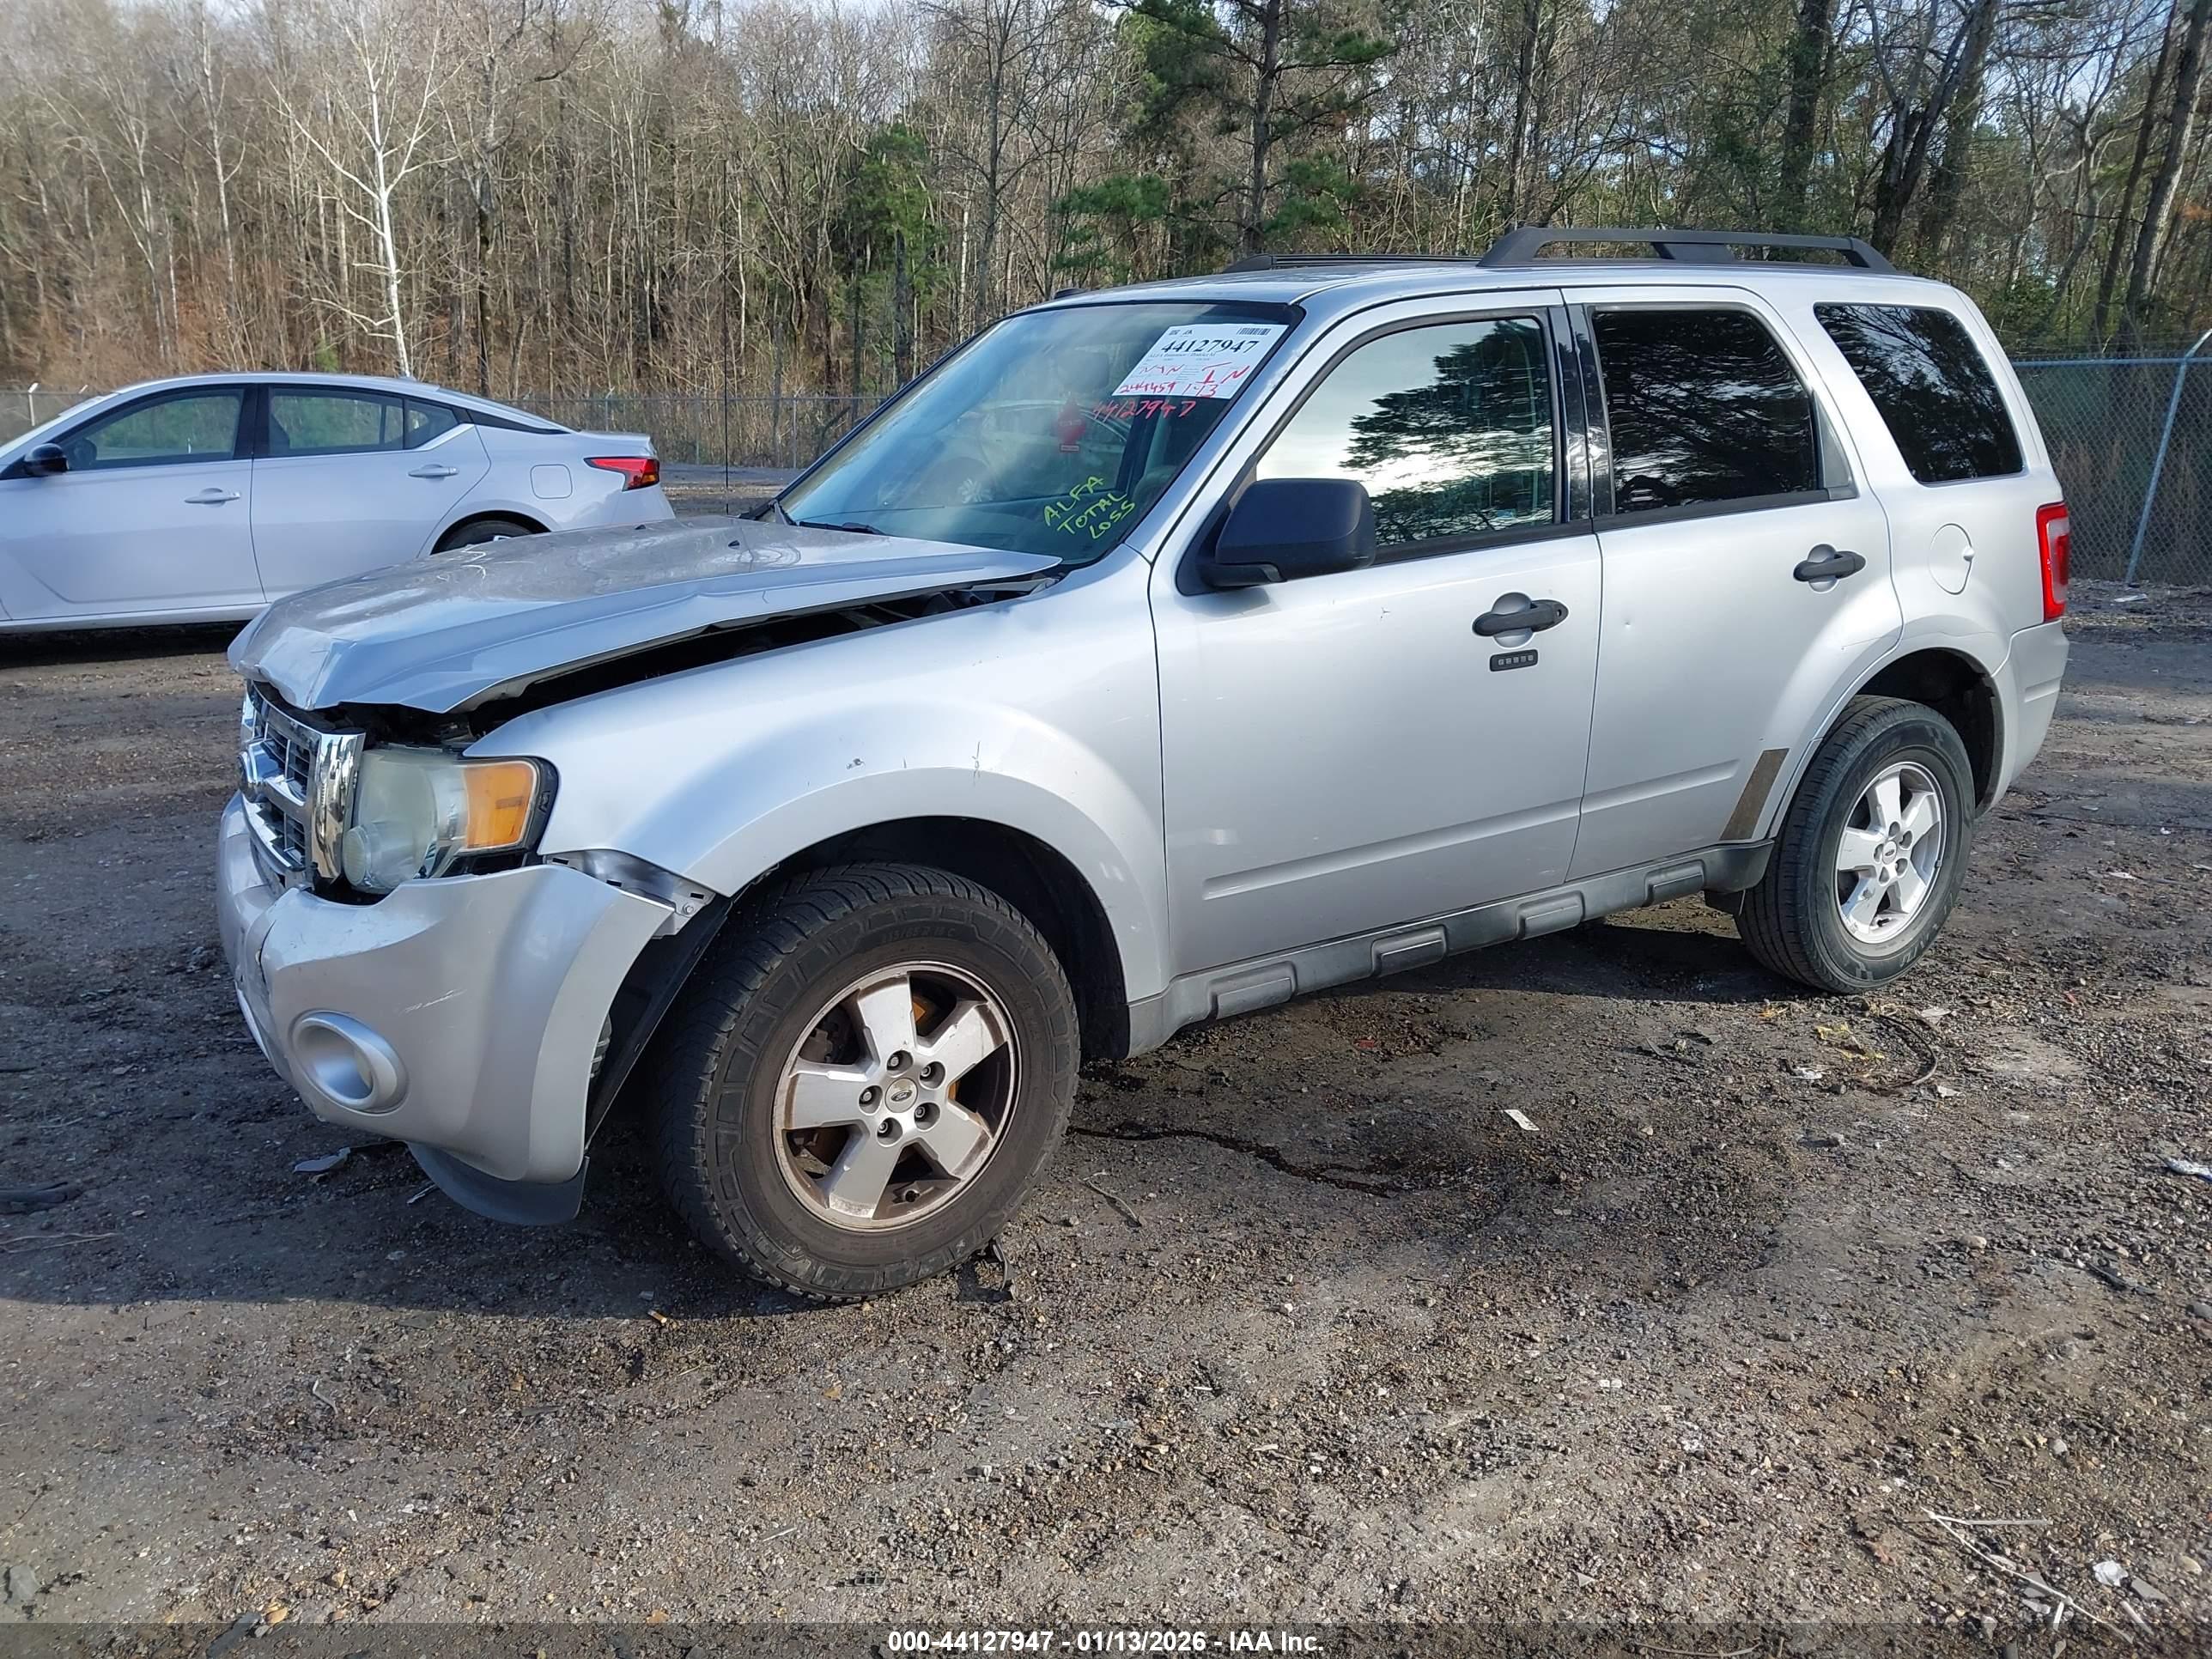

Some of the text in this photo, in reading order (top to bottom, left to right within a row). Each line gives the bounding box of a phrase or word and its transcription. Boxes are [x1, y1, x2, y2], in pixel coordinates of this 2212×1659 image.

[1161, 339, 1259, 353] 44127947
[1093, 398, 1196, 423] 44127947
[1043, 476, 1104, 526] ALFA
[1056, 493, 1127, 534] TOTAL
[1089, 500, 1135, 539] LOSS
